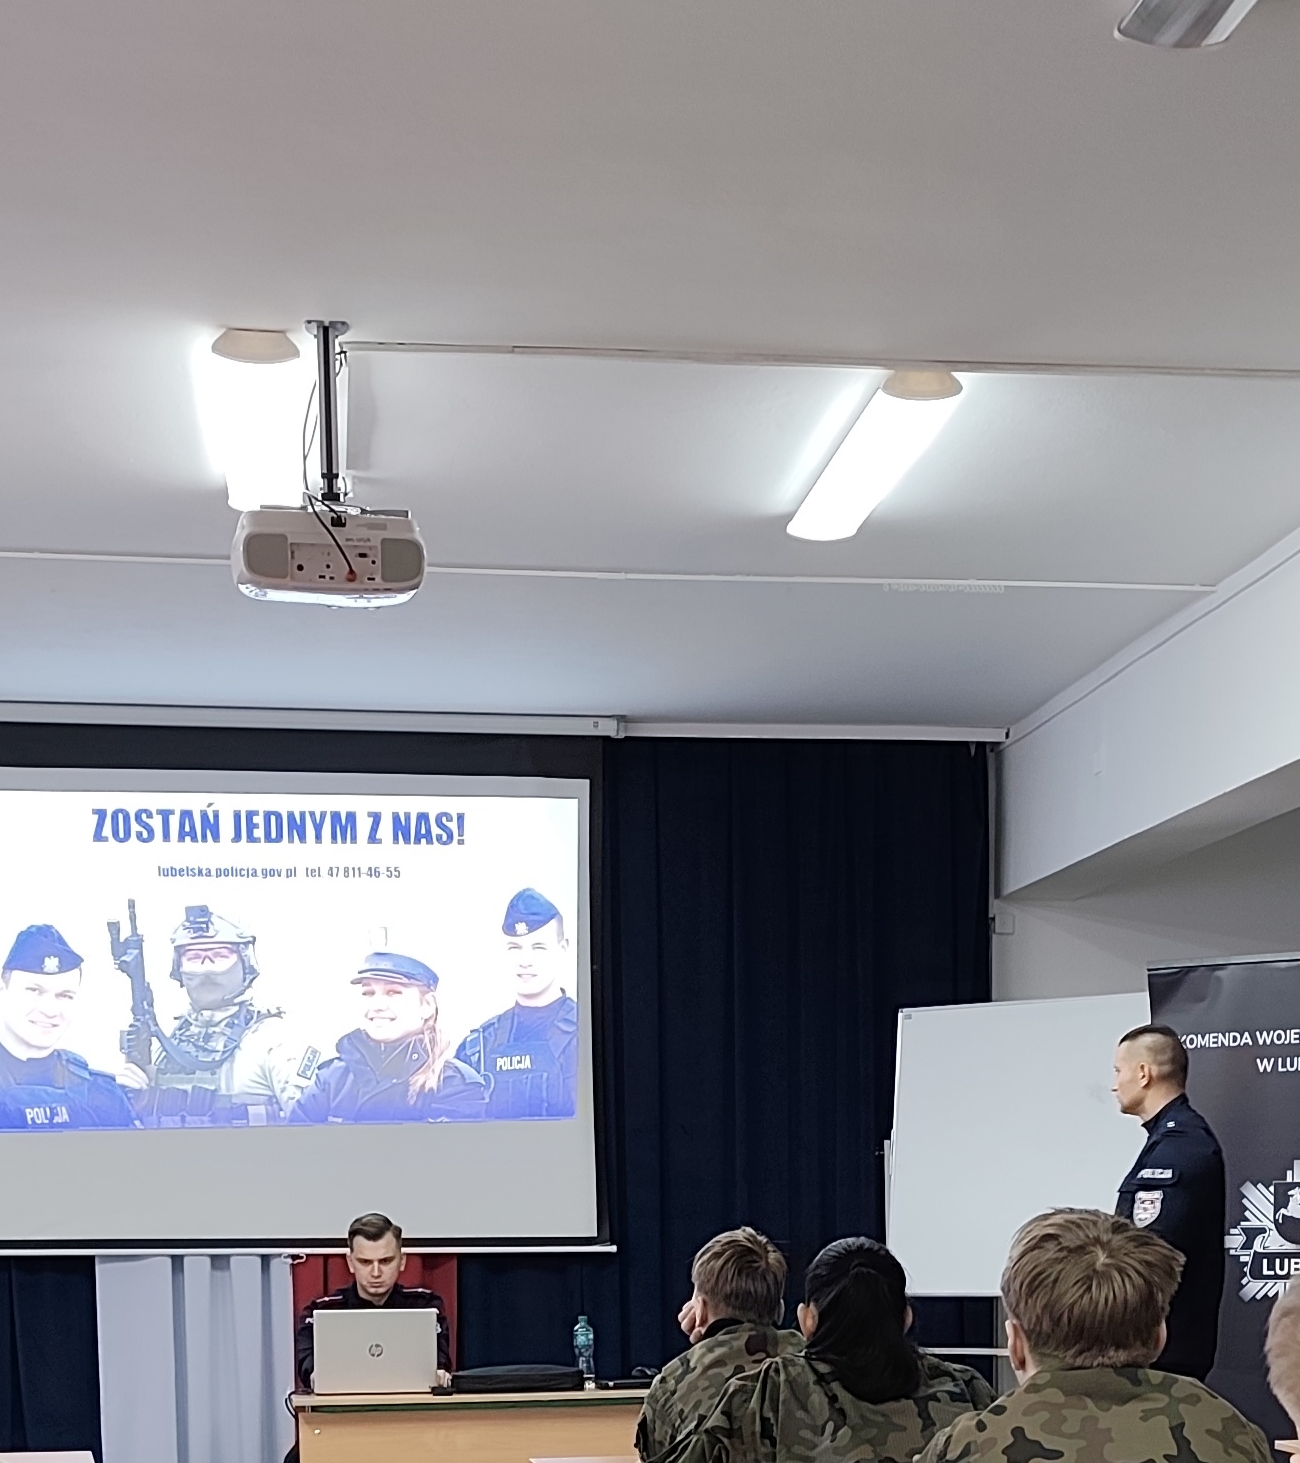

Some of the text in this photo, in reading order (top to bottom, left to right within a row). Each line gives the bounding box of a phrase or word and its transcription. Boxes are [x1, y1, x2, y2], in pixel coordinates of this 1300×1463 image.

[92, 803, 465, 845] ZOSTAŃ JEDNYM Z NAS!
[327, 866, 340, 878] 47
[343, 866, 401, 879] 811-46-55
[496, 1054, 531, 1071] POLICJA
[1256, 1058, 1275, 1073] W
[25, 1106, 70, 1125] POLIJA
